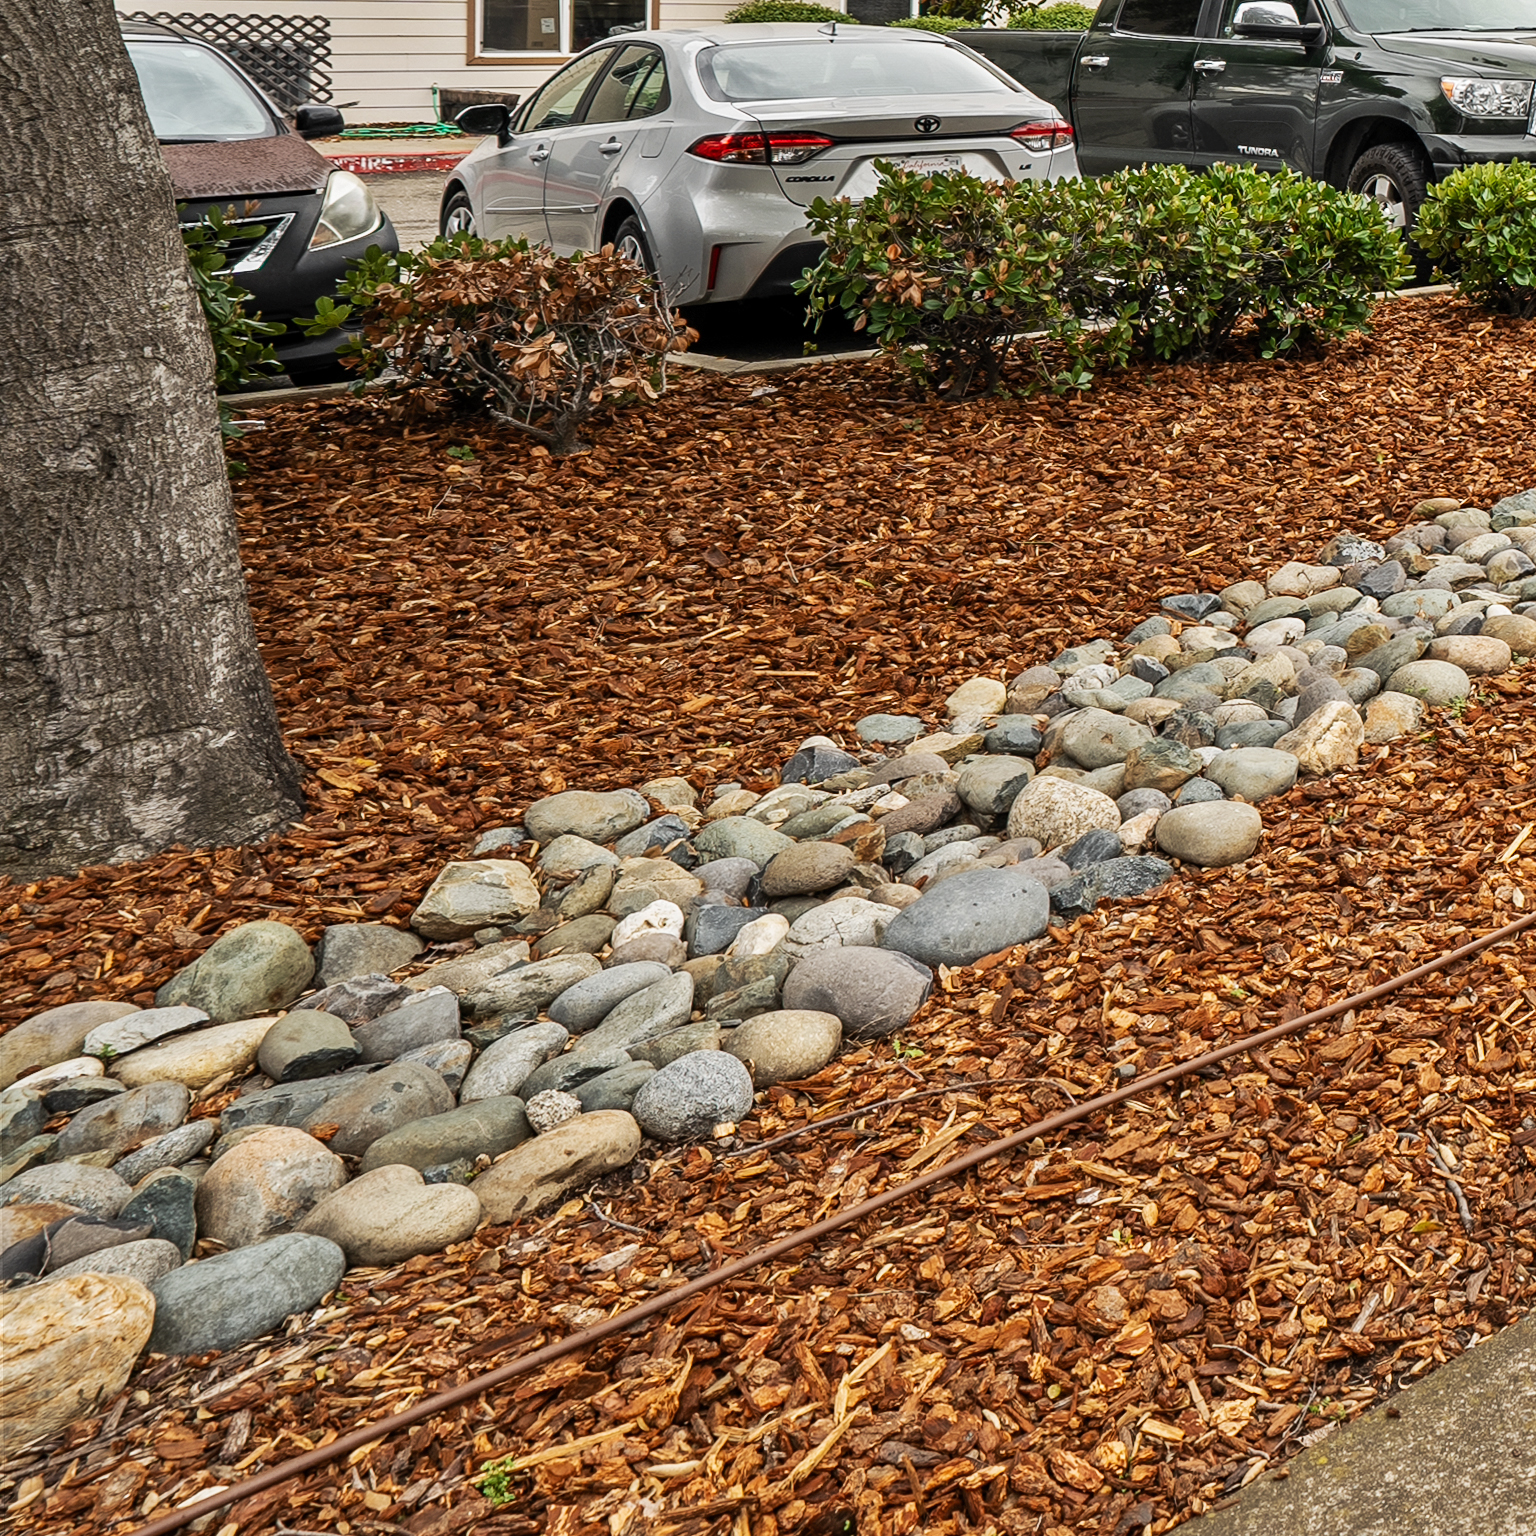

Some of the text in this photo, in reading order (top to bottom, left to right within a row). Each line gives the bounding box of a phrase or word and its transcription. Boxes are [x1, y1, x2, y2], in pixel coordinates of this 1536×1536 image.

[1237, 145, 1279, 157] TUNDRA
[903, 159, 944, 170] California
[785, 175, 835, 183] COROLLA
